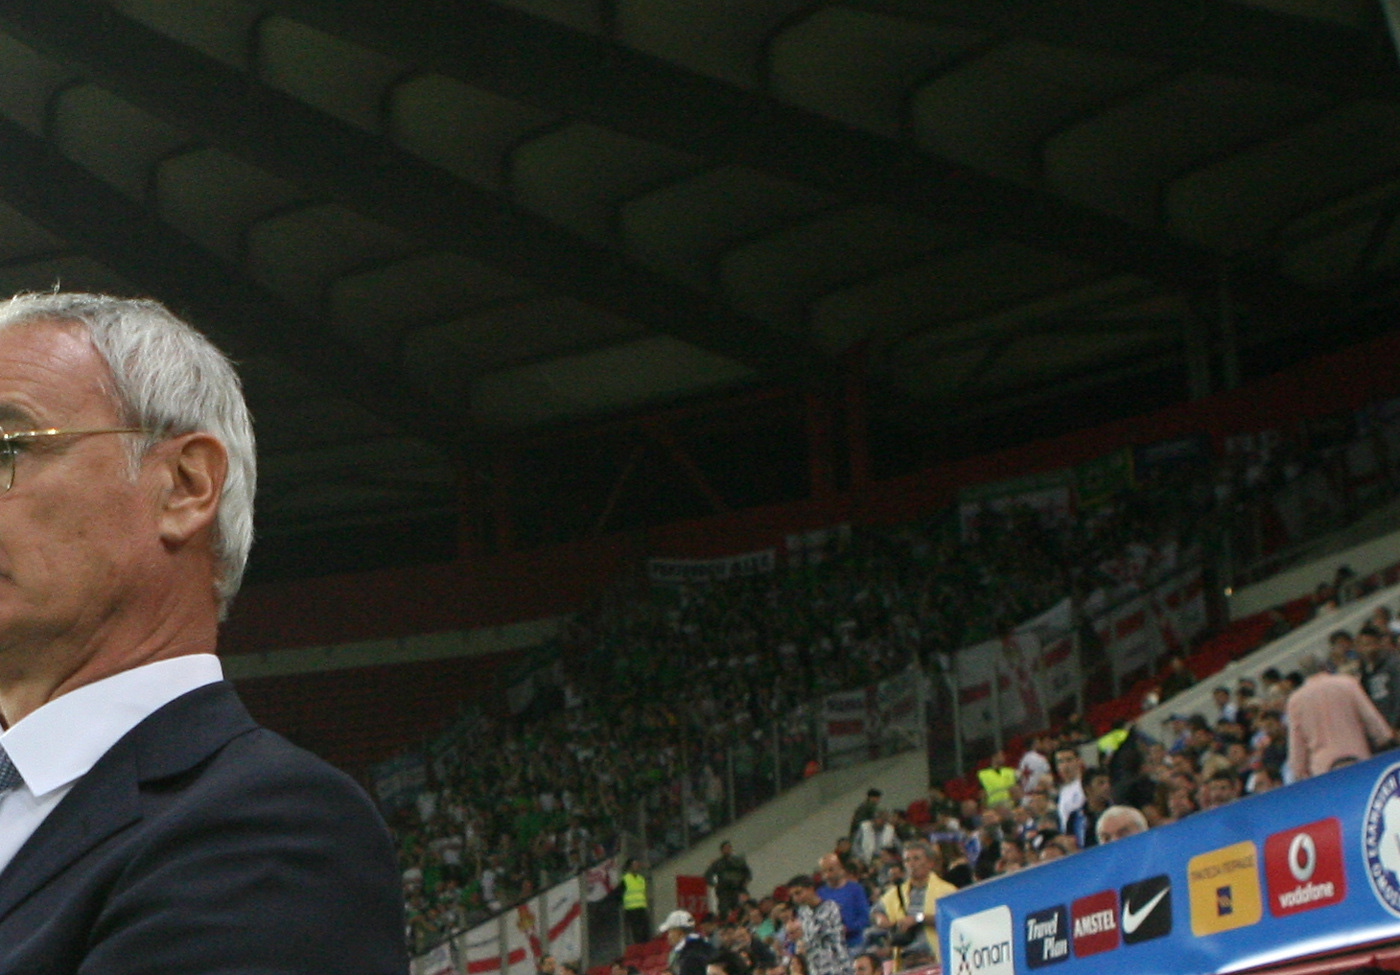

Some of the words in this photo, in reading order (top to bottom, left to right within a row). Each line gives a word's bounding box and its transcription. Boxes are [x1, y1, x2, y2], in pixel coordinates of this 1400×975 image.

[1278, 881, 1335, 909] vodafone
[1025, 912, 1060, 942] Travel
[1073, 909, 1117, 938] AMSTEL
[1042, 936, 1069, 961] Plan
